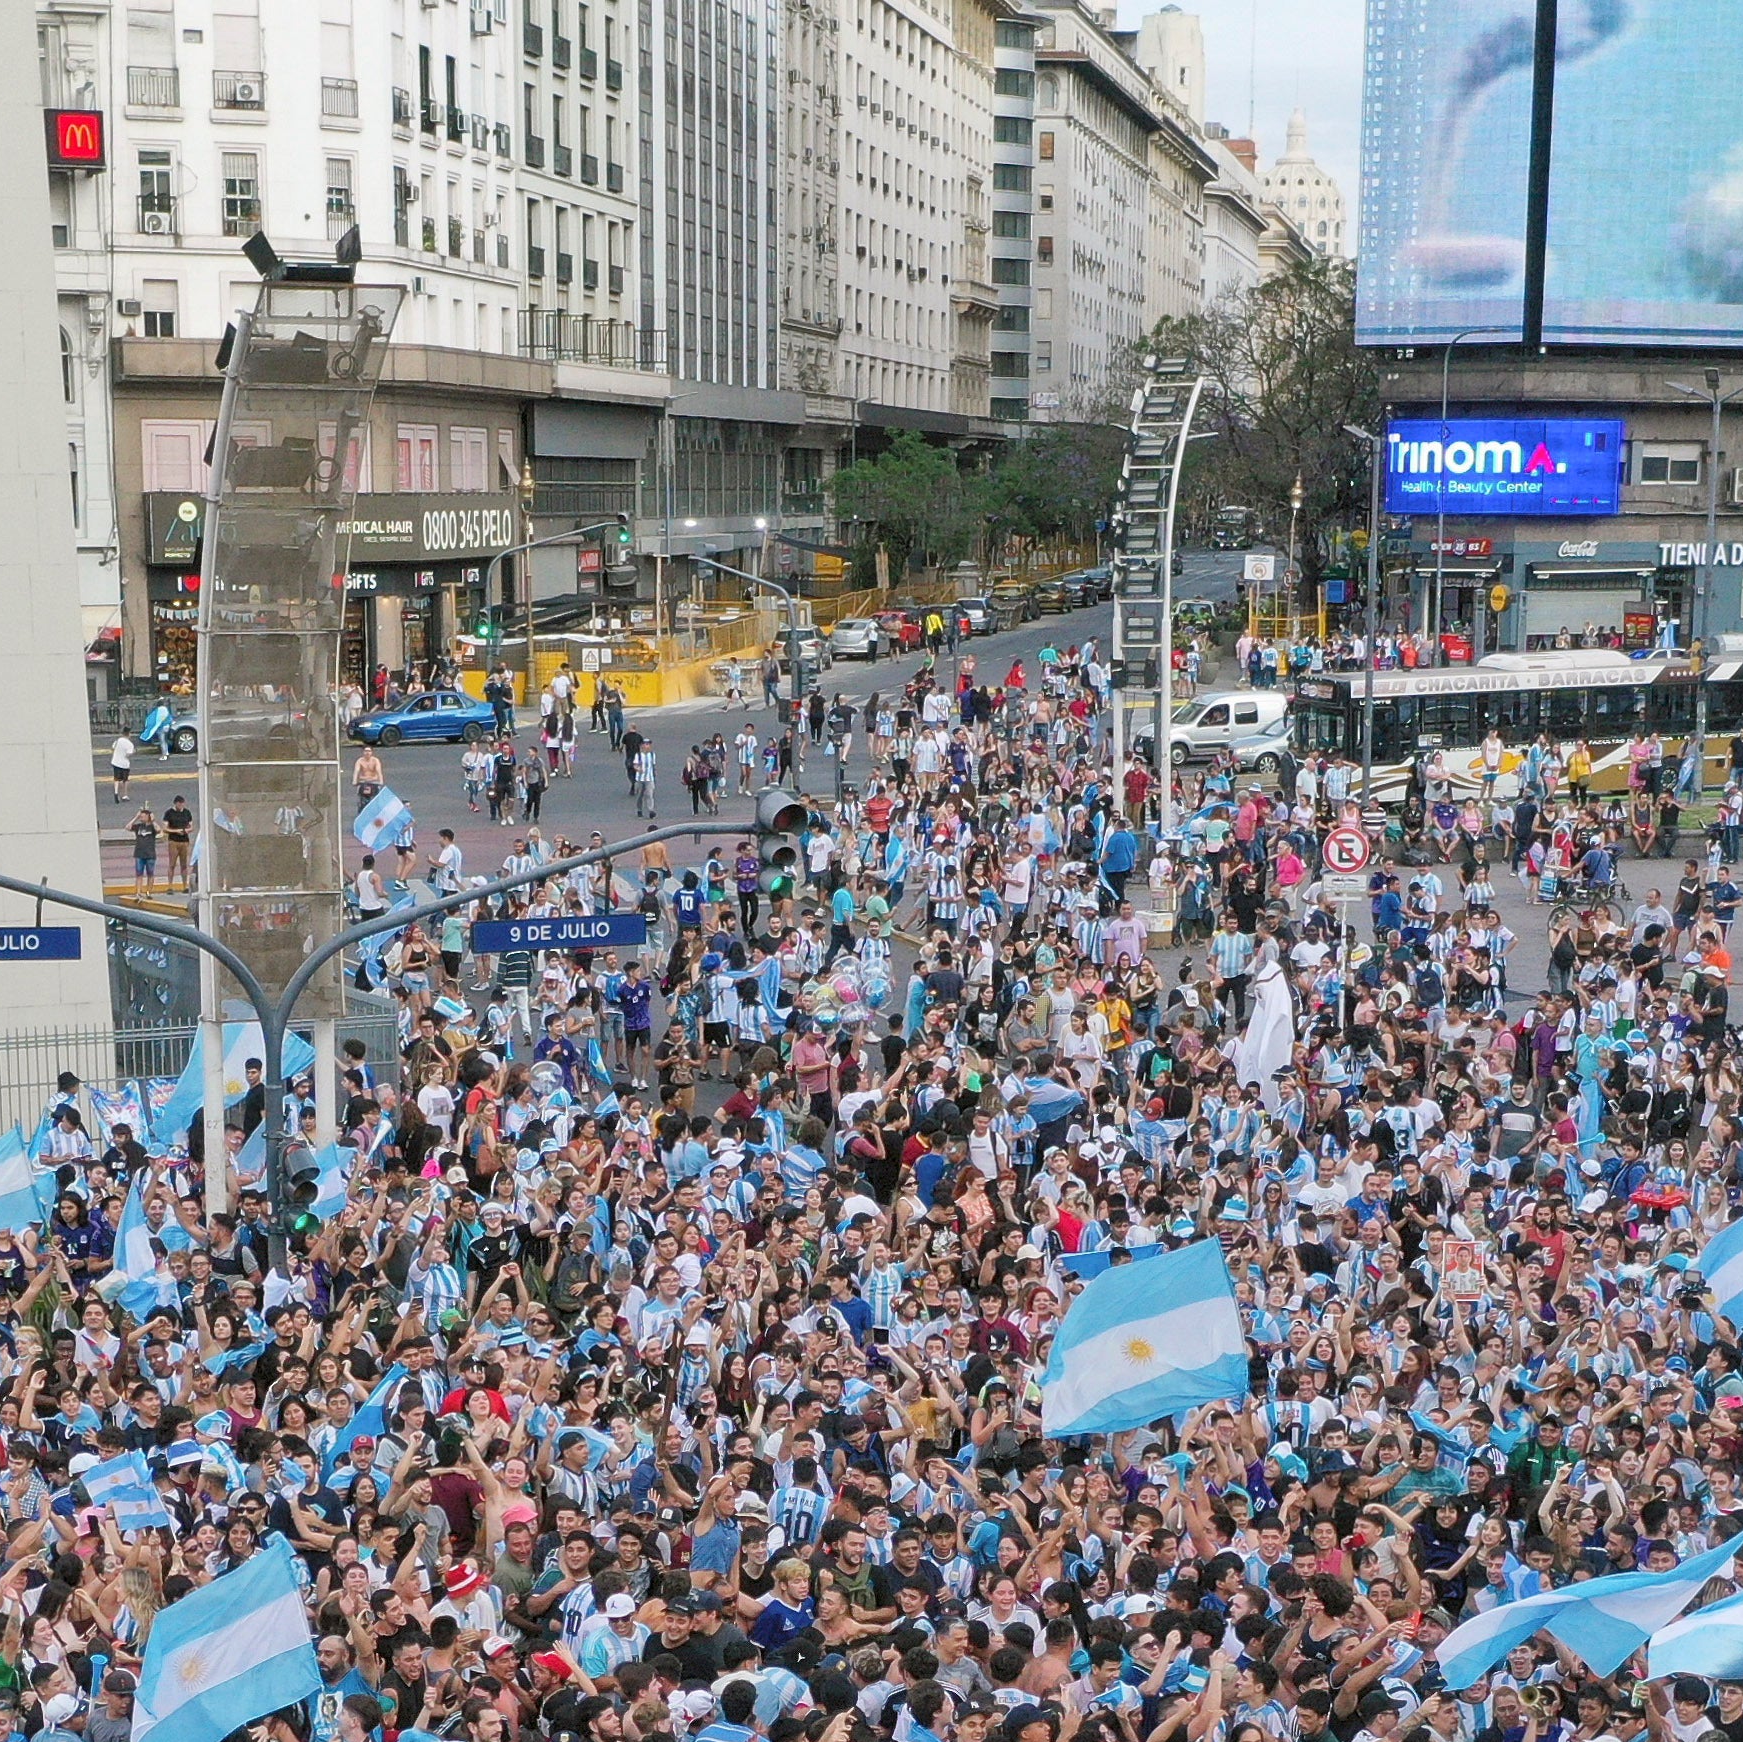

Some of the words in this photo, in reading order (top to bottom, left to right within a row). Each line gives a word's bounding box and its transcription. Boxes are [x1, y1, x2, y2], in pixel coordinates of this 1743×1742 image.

[1402, 480, 1434, 493] Health
[1448, 480, 1494, 495] Beauty
[1496, 480, 1544, 494] Center
[385, 520, 413, 534] HAIR
[422, 511, 458, 551] 0800
[459, 510, 481, 549] 345
[482, 509, 512, 548] PELO
[1659, 542, 1727, 566] TIENA
[1414, 673, 1520, 694] CHACARITA
[1538, 668, 1647, 687] BARRACAS
[679, 893, 694, 911] 10
[509, 926, 521, 943] 9
[527, 925, 552, 941] DE
[557, 921, 610, 940] JULIO
